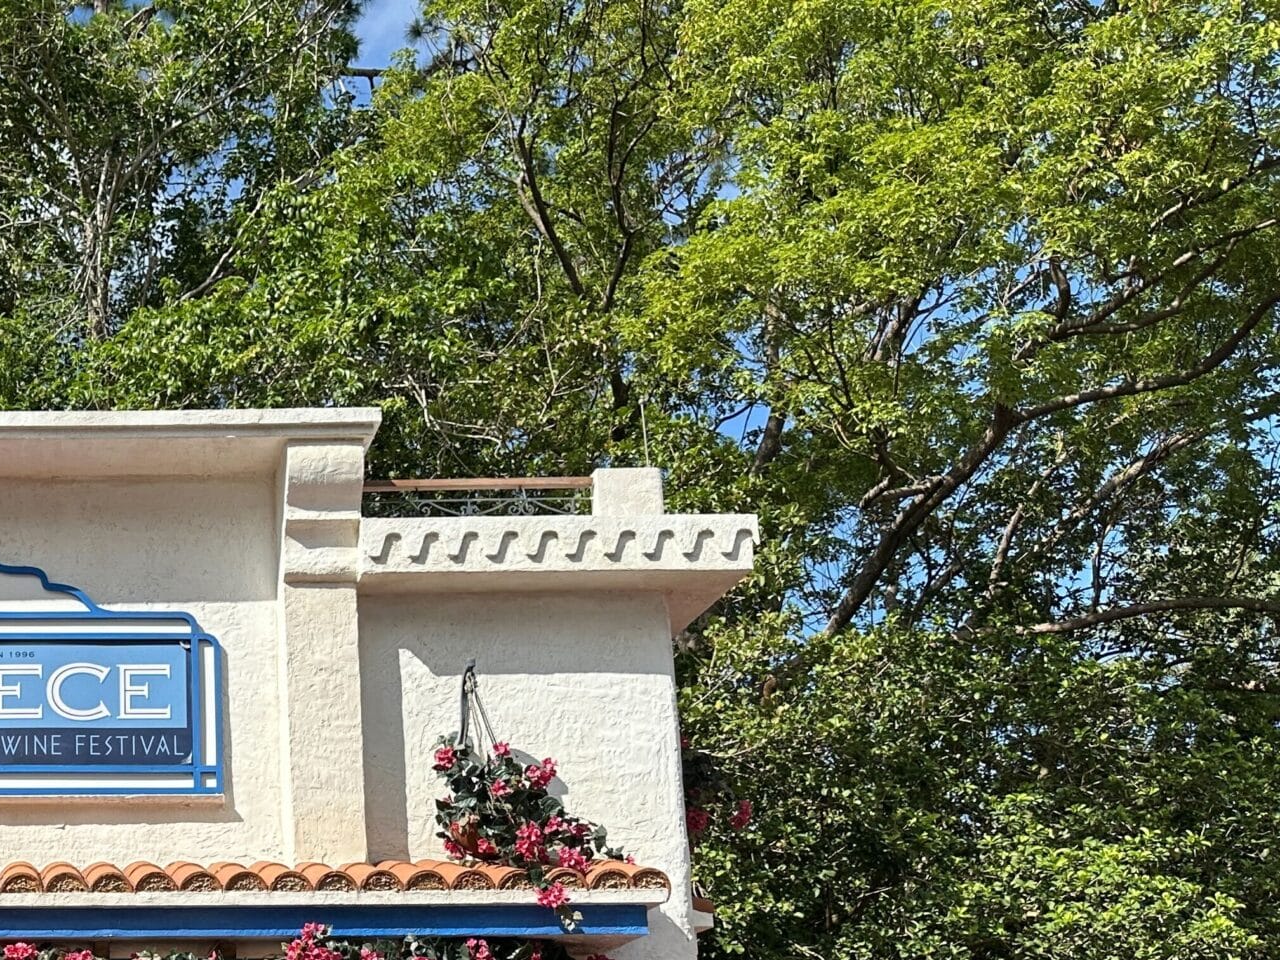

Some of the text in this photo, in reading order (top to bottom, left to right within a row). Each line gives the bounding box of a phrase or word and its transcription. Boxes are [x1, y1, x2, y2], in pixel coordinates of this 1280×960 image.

[9, 651, 36, 659] 1996
[2, 735, 62, 756] WINE
[75, 734, 185, 756] FESTIVAL
